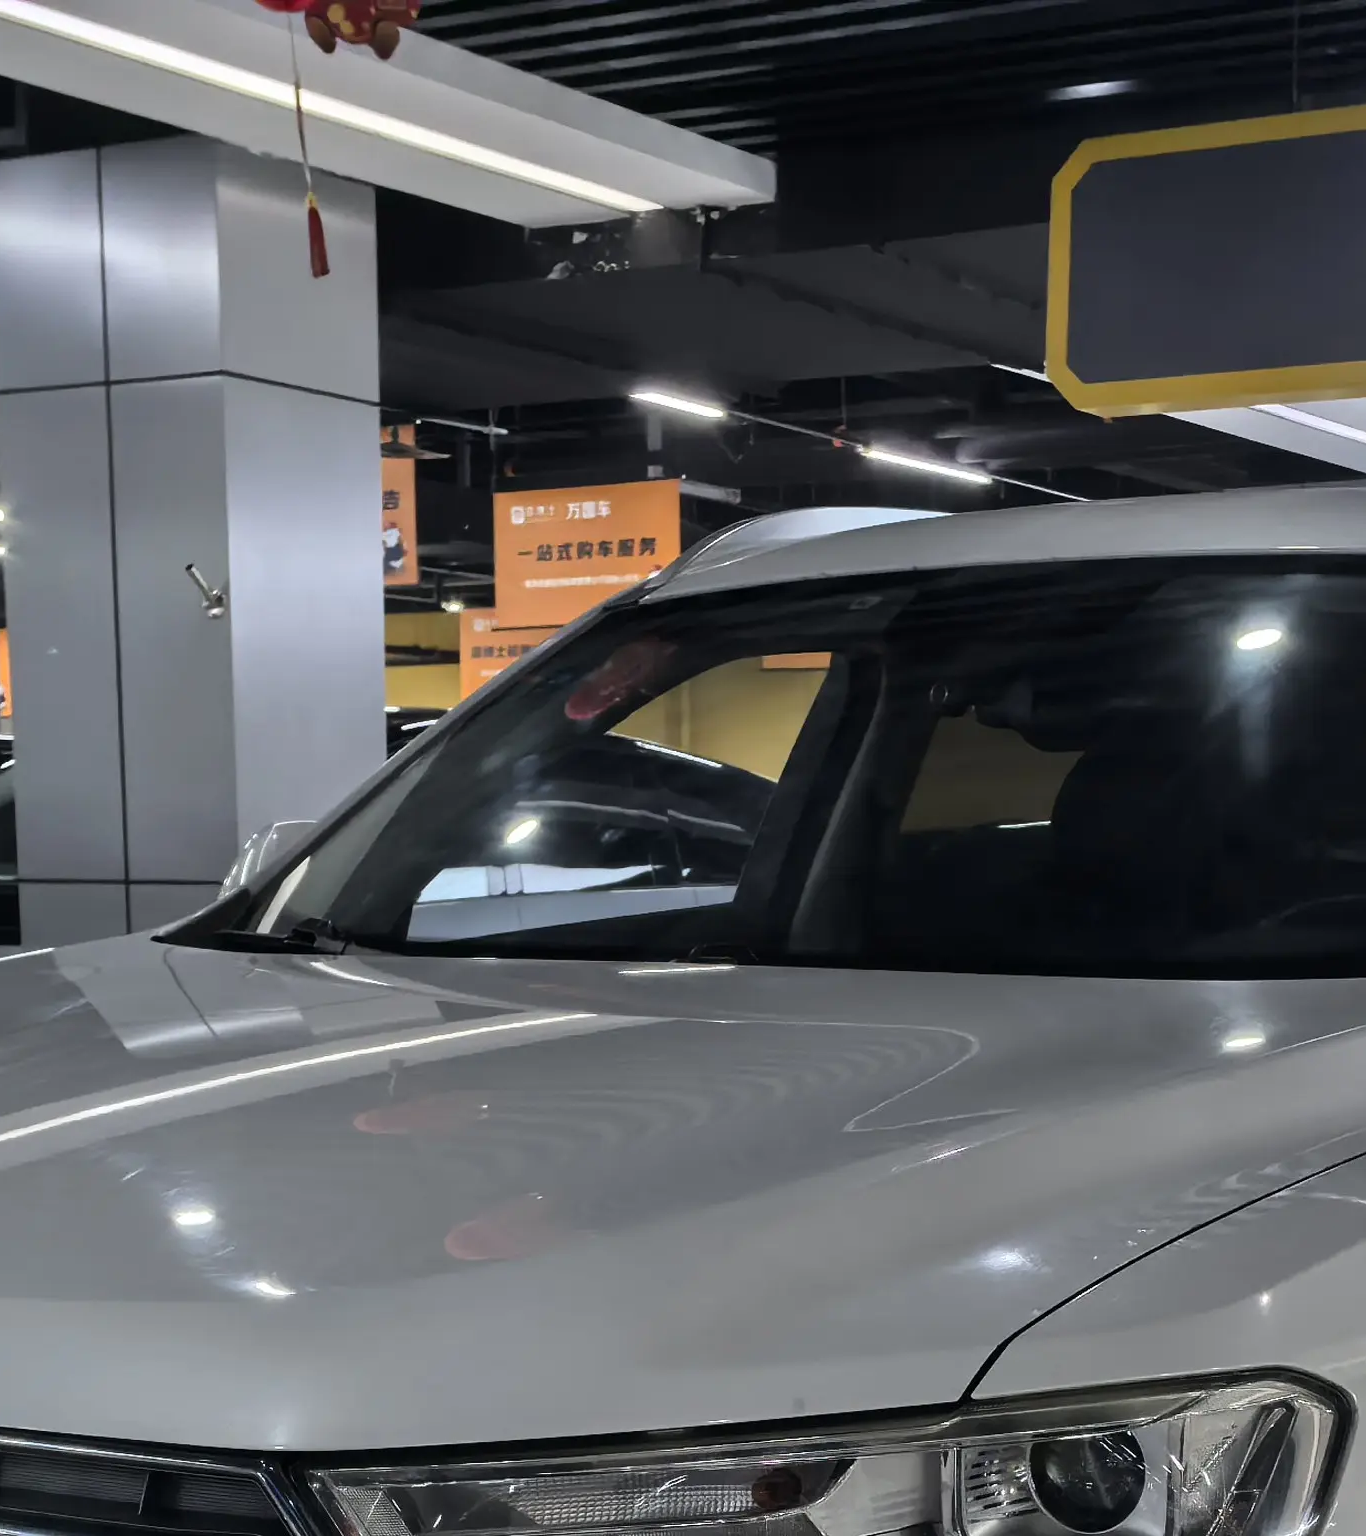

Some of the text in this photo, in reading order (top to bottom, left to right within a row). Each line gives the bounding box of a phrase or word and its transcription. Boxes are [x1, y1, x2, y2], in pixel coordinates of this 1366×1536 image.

[517, 538, 656, 561] 一站式购车服务
